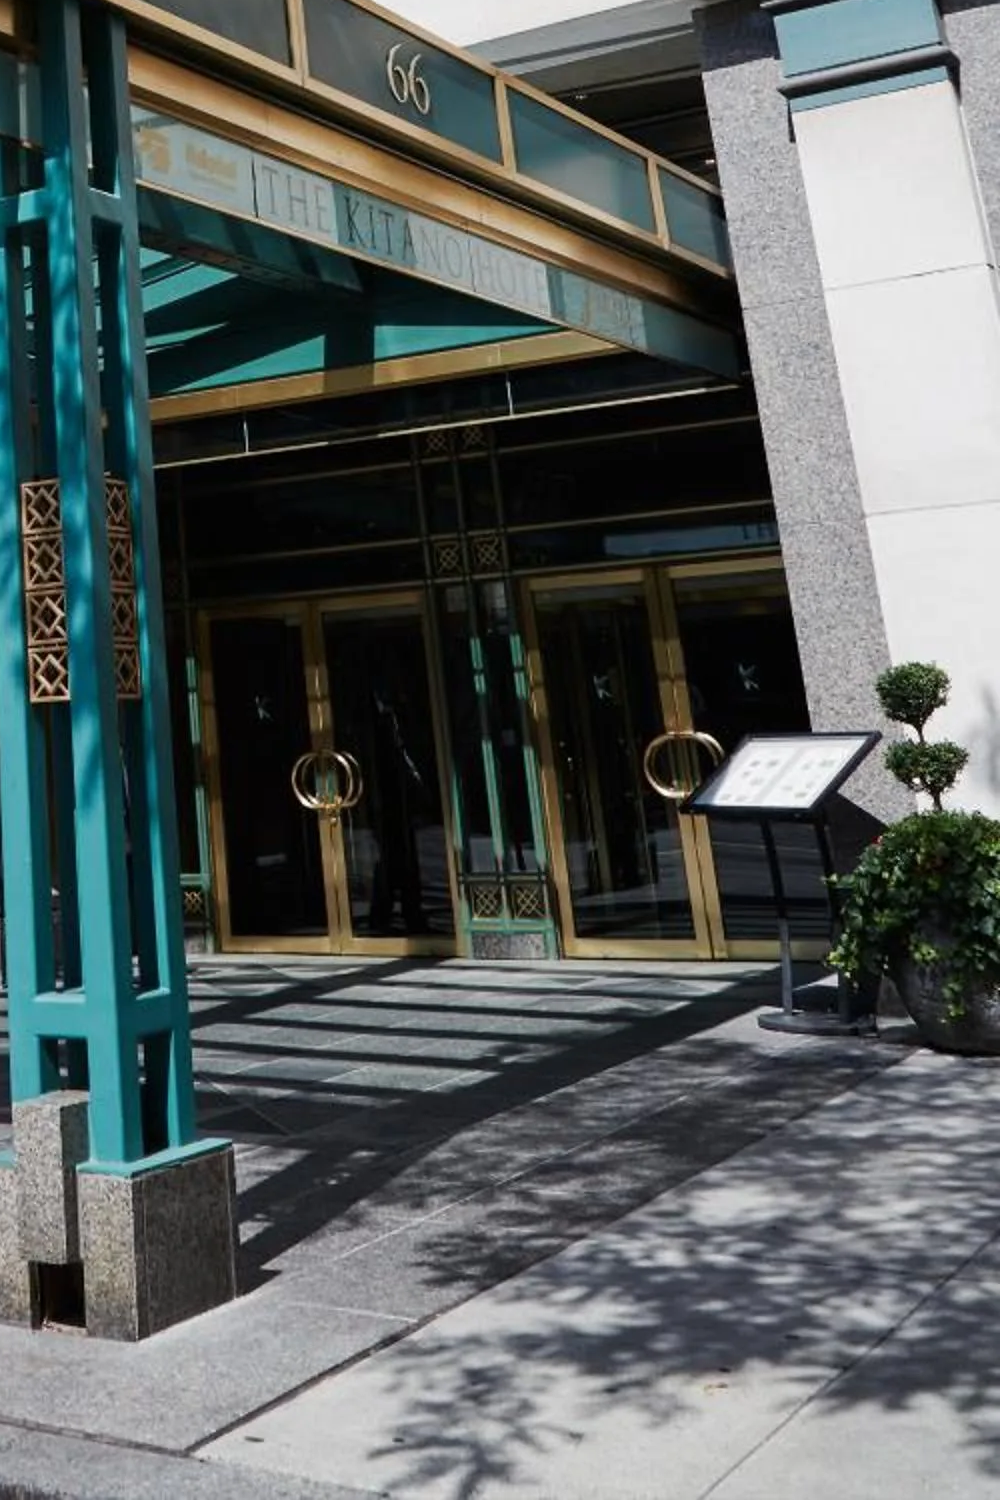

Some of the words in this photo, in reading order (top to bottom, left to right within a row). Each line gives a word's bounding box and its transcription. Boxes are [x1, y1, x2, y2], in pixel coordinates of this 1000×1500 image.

[385, 41, 431, 116] 66
[260, 164, 332, 234] THE
[343, 195, 465, 279] KITANO
